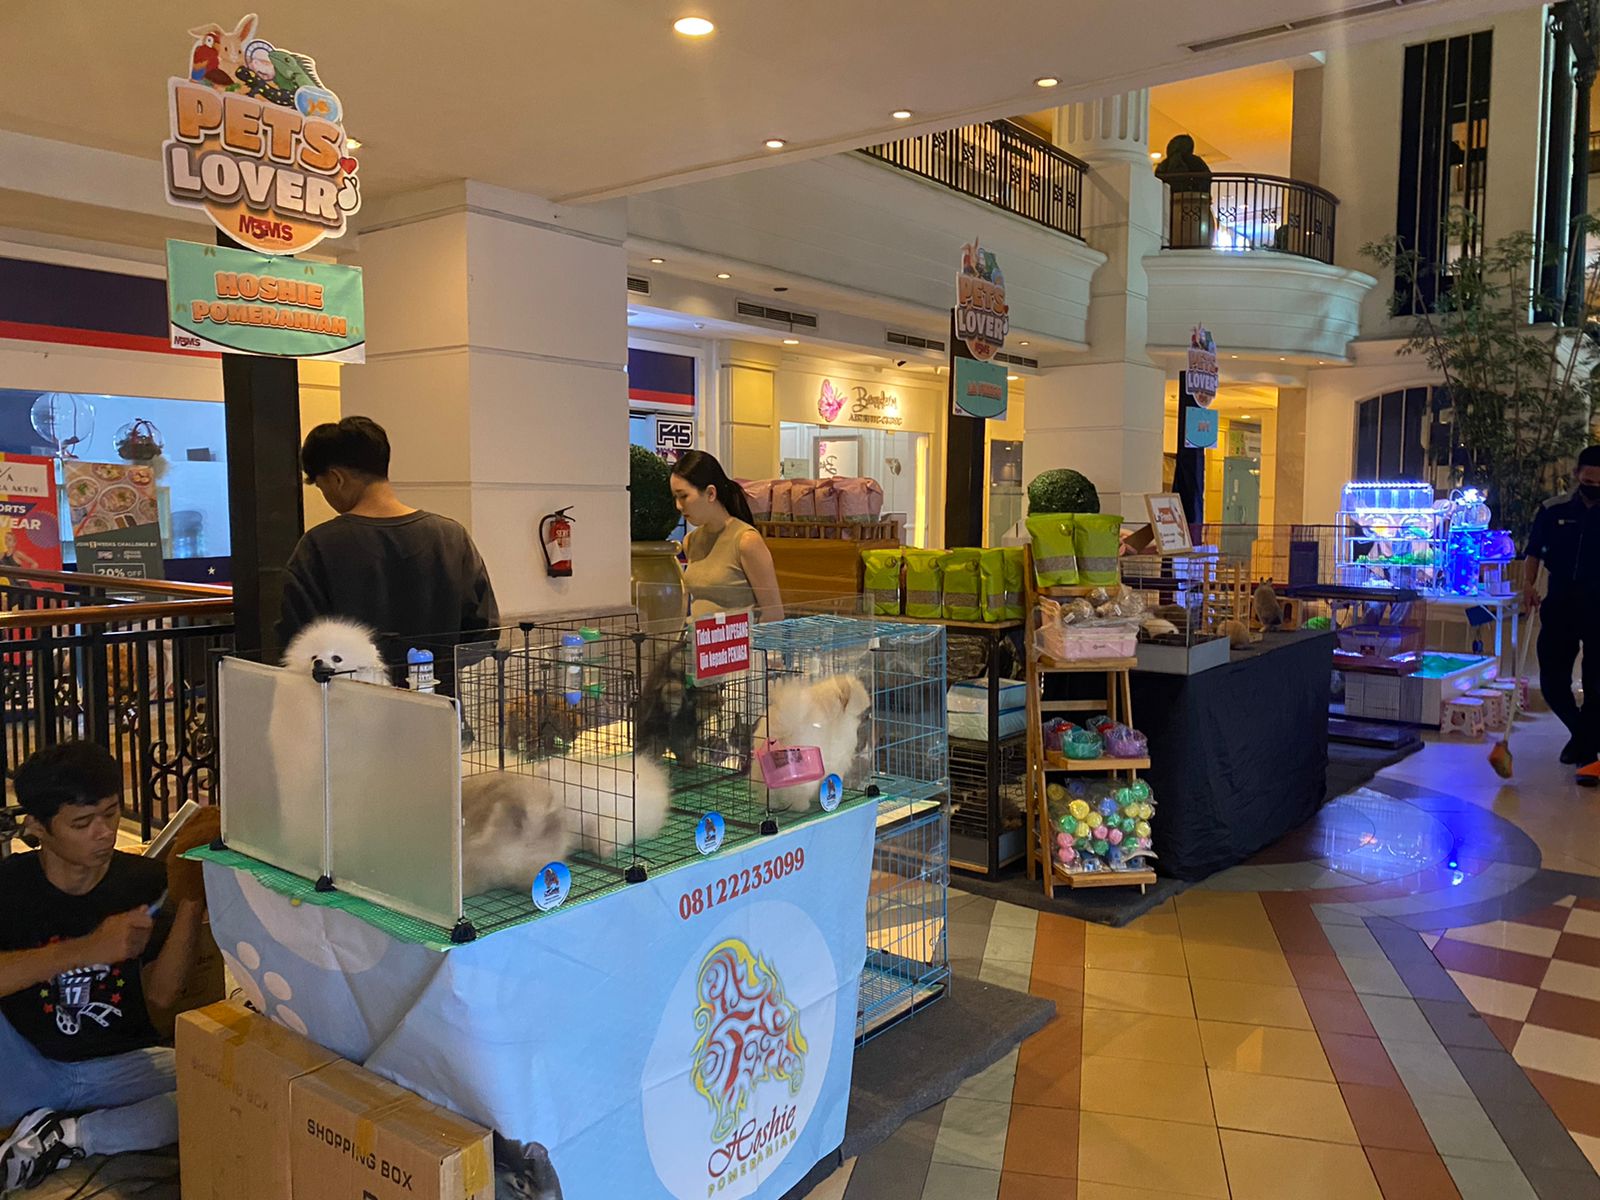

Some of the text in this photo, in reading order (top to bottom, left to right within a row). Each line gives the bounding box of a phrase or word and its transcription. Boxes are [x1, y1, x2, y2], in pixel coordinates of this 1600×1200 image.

[175, 85, 341, 172] PETS
[215, 271, 325, 309] HOSHIE
[958, 275, 1005, 314] PETS
[192, 300, 348, 338] POMERANIAN
[658, 422, 691, 446] F45
[12, 485, 38, 493] AKTIV
[97, 568, 125, 577] 20%
[696, 621, 748, 646] Tidak untuk DIPEGANG
[708, 649, 728, 668] kepada
[727, 644, 748, 663] PENJAGA
[678, 847, 805, 921] 08122233099
[65, 986, 82, 1005] 17
[307, 1118, 413, 1192] SHOPPING BOX
[708, 1105, 797, 1178] Hoshie
[708, 1127, 798, 1199] POMERANIAN
